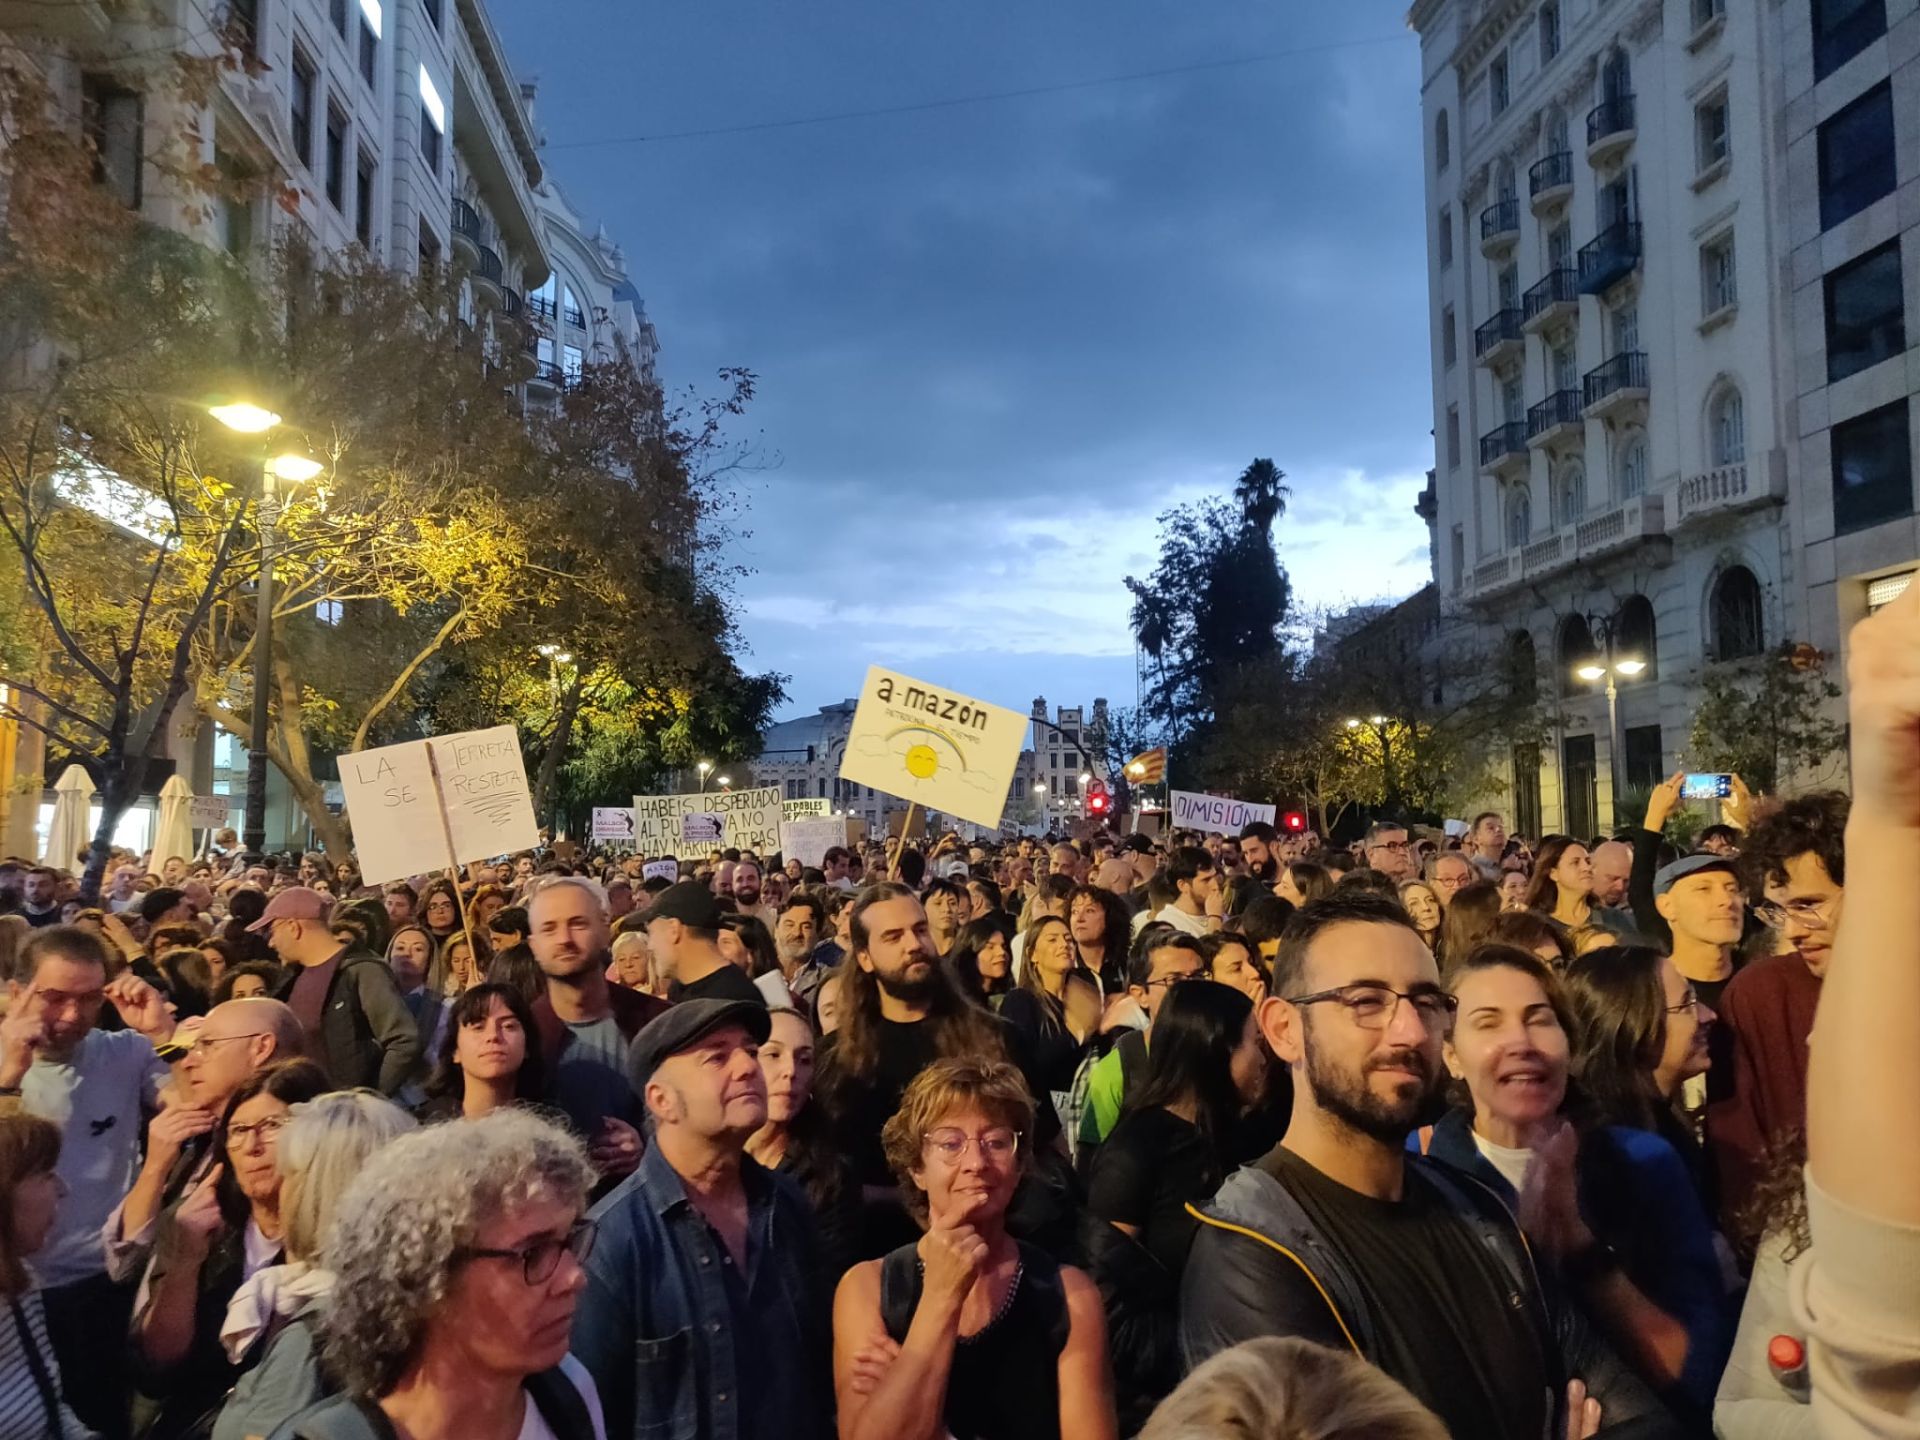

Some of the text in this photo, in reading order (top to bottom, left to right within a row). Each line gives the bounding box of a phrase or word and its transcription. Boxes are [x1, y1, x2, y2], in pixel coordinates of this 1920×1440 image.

[877, 677, 988, 731] a-mazón
[355, 757, 397, 784] LA
[384, 770, 522, 807] SE RESPETA
[704, 788, 780, 812] DESPERTADO
[641, 820, 657, 840] AL
[742, 811, 764, 828] NO
[642, 838, 668, 857] HAY
